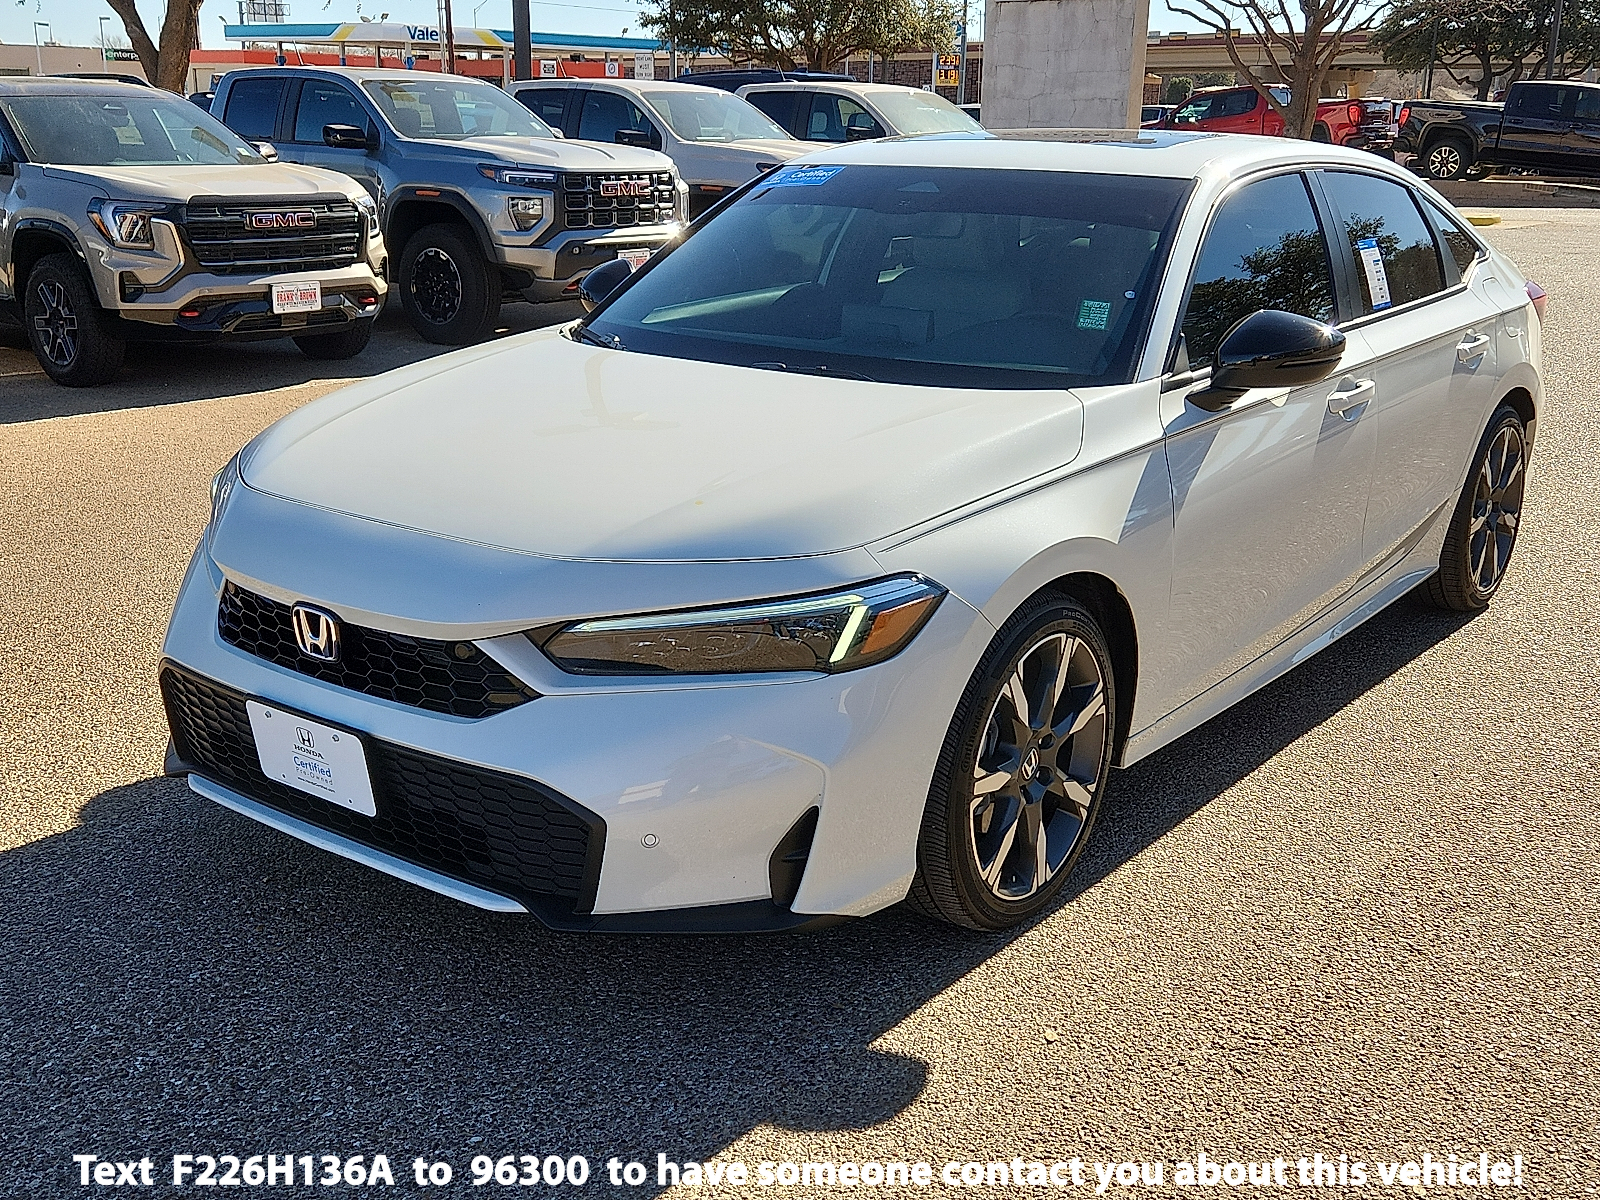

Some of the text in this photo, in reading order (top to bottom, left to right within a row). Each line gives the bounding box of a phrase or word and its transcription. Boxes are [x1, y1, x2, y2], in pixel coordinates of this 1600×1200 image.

[406, 25, 454, 41] Vale
[106, 51, 139, 60] enterp
[601, 181, 651, 197] GMC
[252, 213, 314, 227] GMC
[293, 743, 325, 760] HONDA
[293, 756, 332, 779] Certified
